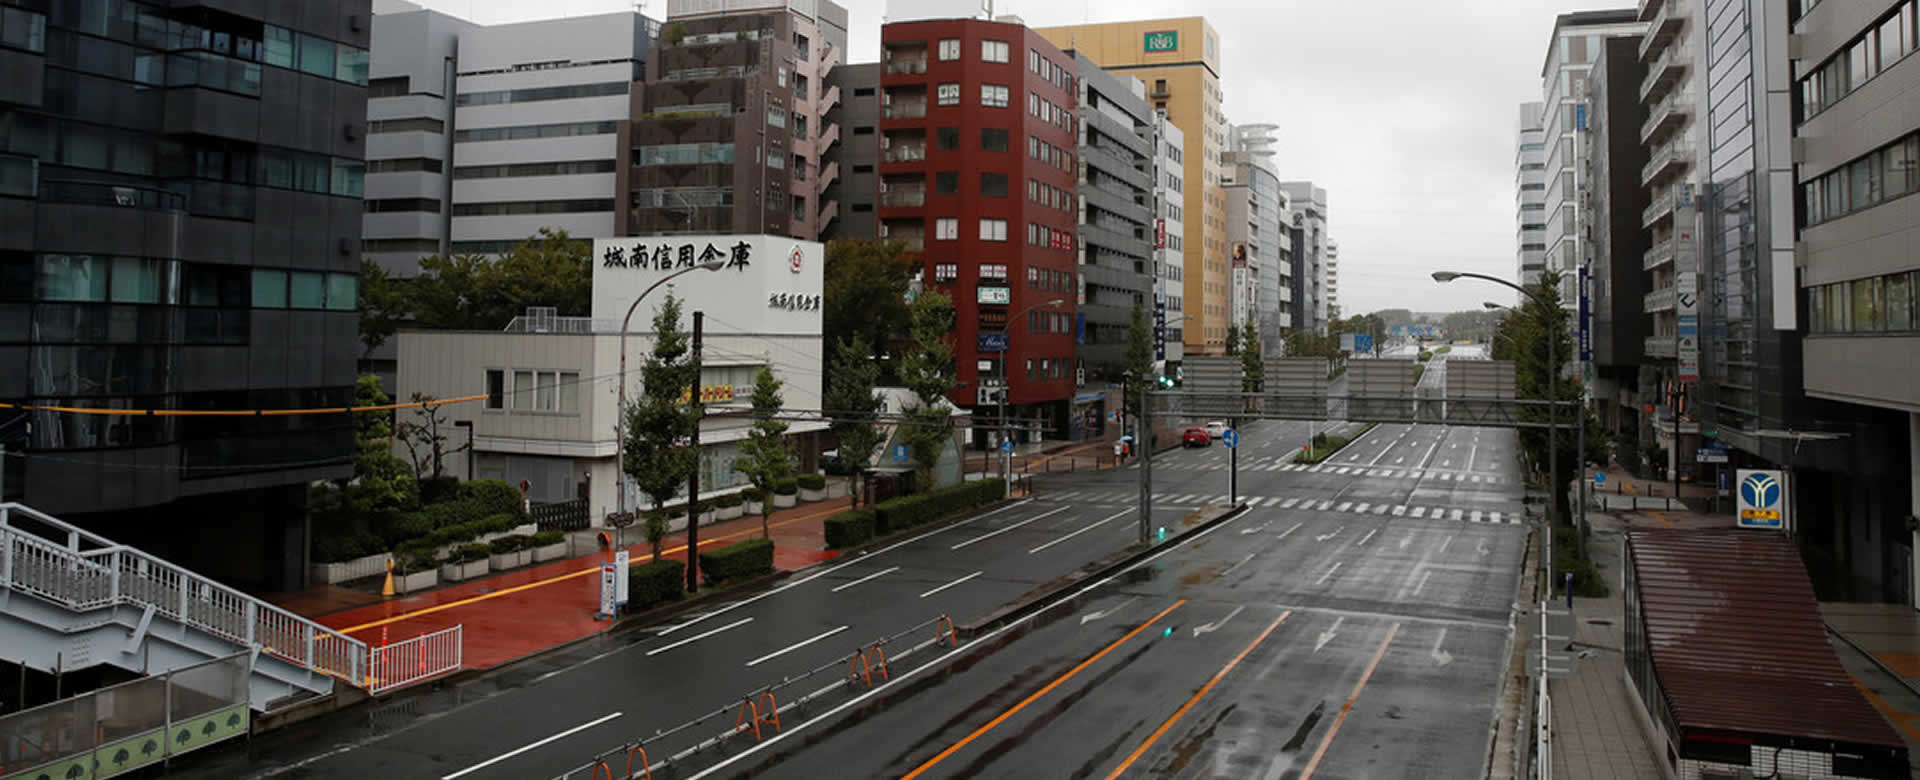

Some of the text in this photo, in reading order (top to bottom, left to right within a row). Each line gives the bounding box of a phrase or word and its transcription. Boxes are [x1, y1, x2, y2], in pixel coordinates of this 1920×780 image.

[1149, 34, 1174, 49] R&B
[603, 241, 752, 272] 城南信用金庫
